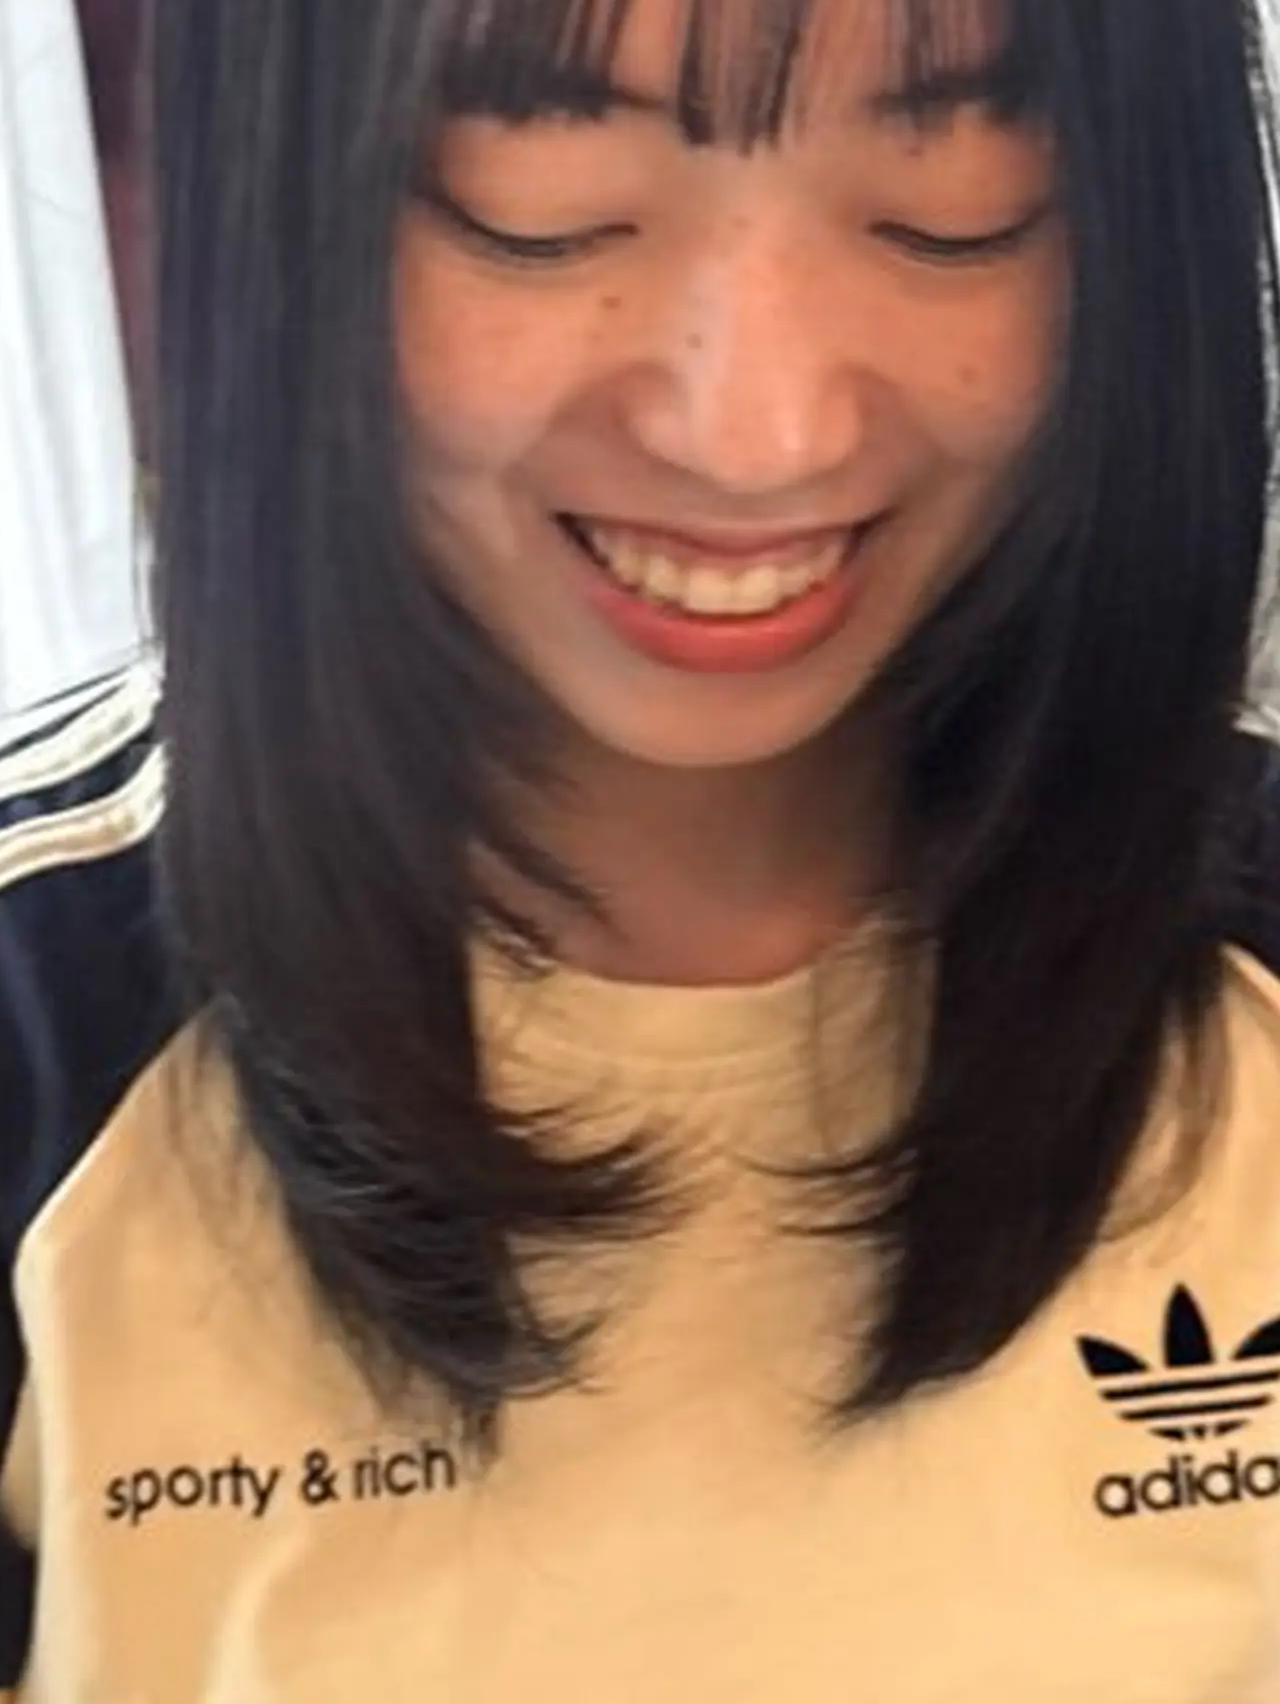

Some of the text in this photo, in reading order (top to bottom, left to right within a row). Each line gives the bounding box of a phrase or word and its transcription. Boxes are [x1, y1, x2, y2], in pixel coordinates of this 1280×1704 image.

[107, 1441, 456, 1526] sporty & rich
